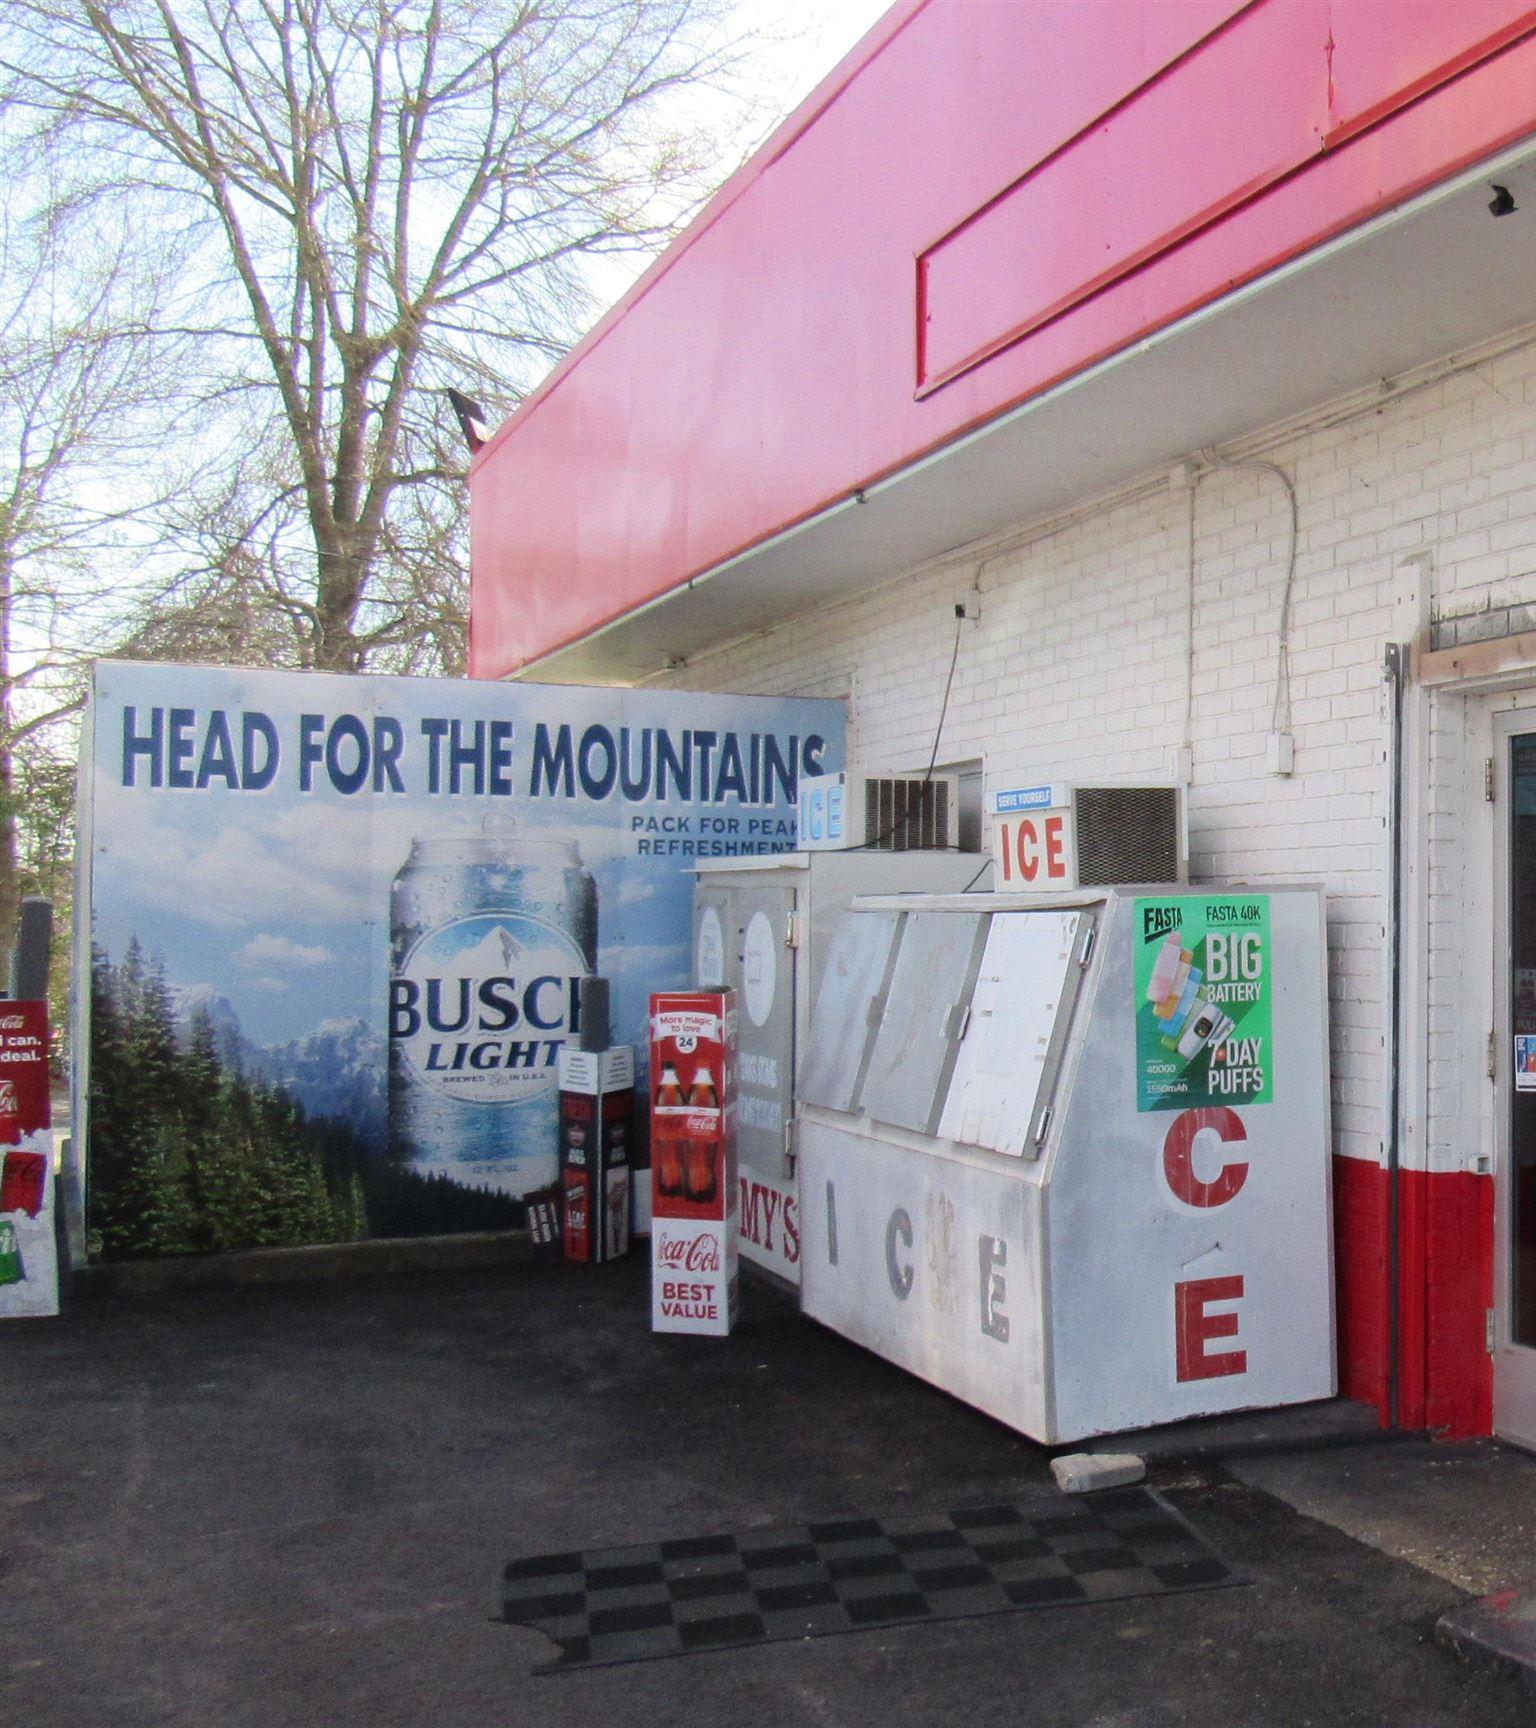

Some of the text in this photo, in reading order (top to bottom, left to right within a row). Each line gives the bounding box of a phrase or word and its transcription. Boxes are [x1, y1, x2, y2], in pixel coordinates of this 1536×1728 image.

[122, 706, 825, 805] HEAD FOR THE MOUNTAINS
[998, 791, 1050, 807] SERVE YOURSELF
[801, 786, 842, 841] ICE
[631, 816, 690, 833] PACK
[700, 817, 740, 835] FOR
[638, 839, 798, 856] REFRESHMENT
[1001, 817, 1066, 882] ICE
[1144, 907, 1182, 934] FASTA
[1206, 905, 1261, 921] FASTA 40K
[1206, 933, 1262, 982] BIG
[1207, 983, 1261, 1003] BATTERY
[660, 1016, 713, 1027] More magic
[671, 1024, 701, 1032] to love
[8, 1035, 41, 1046] can.
[679, 1037, 693, 1047] 24
[0, 1050, 41, 1062] deal.
[425, 1040, 566, 1071] LIGHT
[1208, 1037, 1262, 1068] 7 DAY
[1208, 1066, 1264, 1095] PUFFS
[658, 1232, 720, 1272] Coca-Cola
[663, 1281, 715, 1301] BEST
[661, 1302, 718, 1319] VALUE
